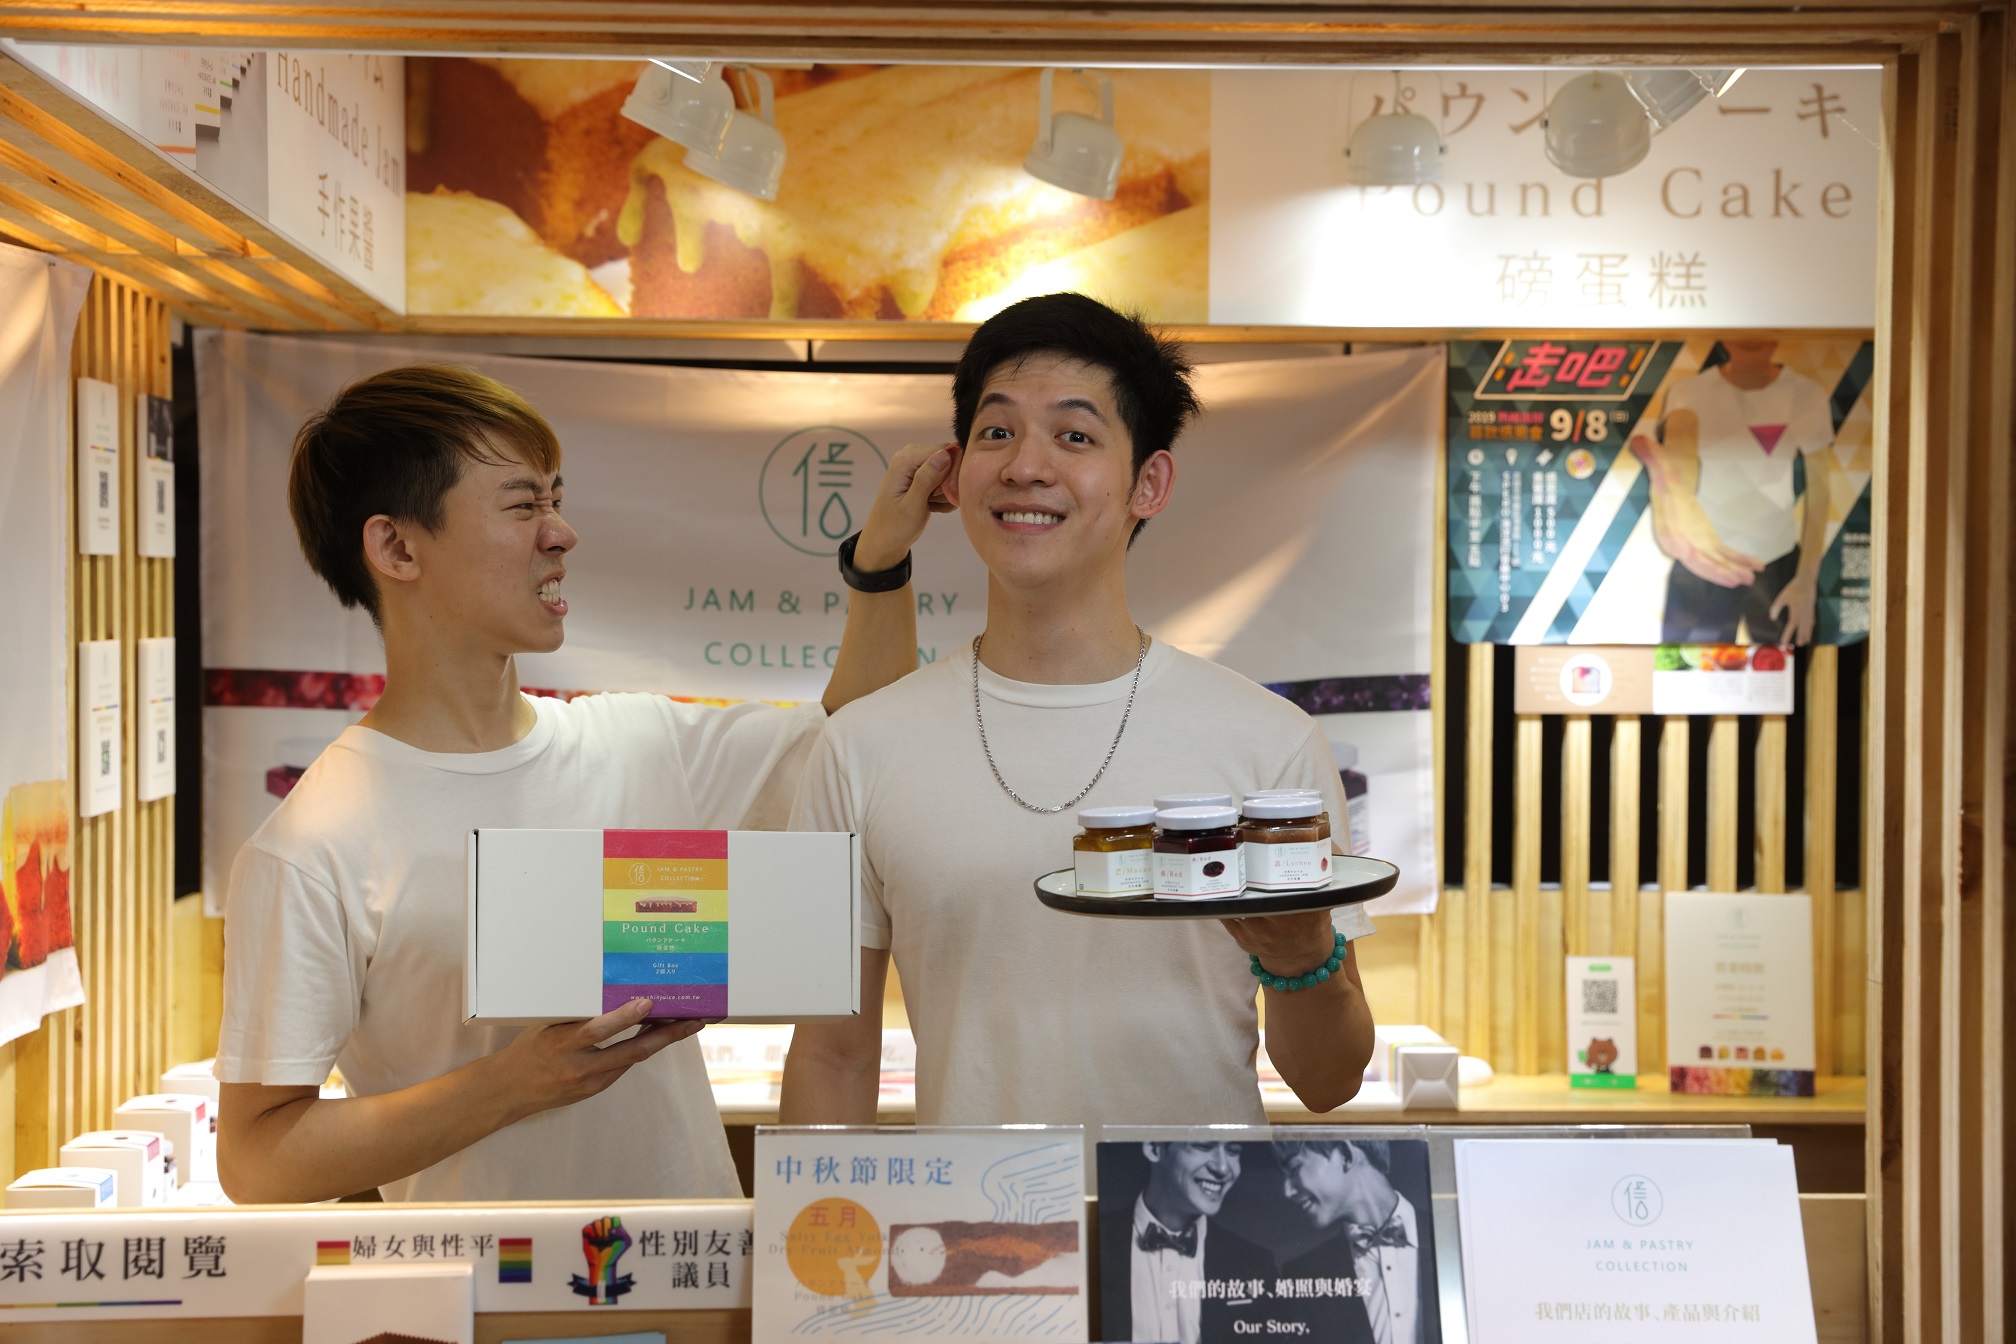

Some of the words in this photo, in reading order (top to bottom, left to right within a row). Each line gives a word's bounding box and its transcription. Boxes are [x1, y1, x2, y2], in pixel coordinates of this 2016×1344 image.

[1369, 81, 1848, 140] パウンーキ
[277, 53, 369, 166] Handmade
[375, 124, 401, 198] Jam
[1661, 166, 1854, 219] Cake
[1497, 249, 1708, 309] 磅蛋糕
[1549, 408, 1609, 443] 9/8
[684, 587, 756, 612] JAM
[777, 590, 803, 614] &
[824, 592, 959, 616] PRY
[704, 641, 938, 669] COLLECN
[621, 922, 667, 934] Pound
[674, 923, 710, 934] Cake
[630, 994, 701, 1002] wwwshinjuice.com.tw
[775, 1154, 955, 1187] 中秋節限定
[808, 1205, 857, 1229] 五月
[352, 1233, 495, 1260] 婦女與性平
[768, 1244, 793, 1257] Dry
[801, 1244, 838, 1255] Fruit
[779, 1231, 816, 1243] Salty
[824, 1231, 851, 1244] Egg
[858, 1231, 889, 1242] Yolk
[1585, 1238, 1615, 1250] JAM
[1622, 1239, 1633, 1251] &
[1640, 1239, 1694, 1251] PASTRY
[0, 1234, 229, 1283] 索取閱覽
[1595, 1260, 1689, 1272] COLLECTION
[671, 1261, 731, 1290] 議員
[1169, 1276, 1373, 1300] 我們的故事、婚照與婚宴
[1534, 1301, 1762, 1323] 我們店的故事、產品與介紹
[1233, 1319, 1263, 1334] Our
